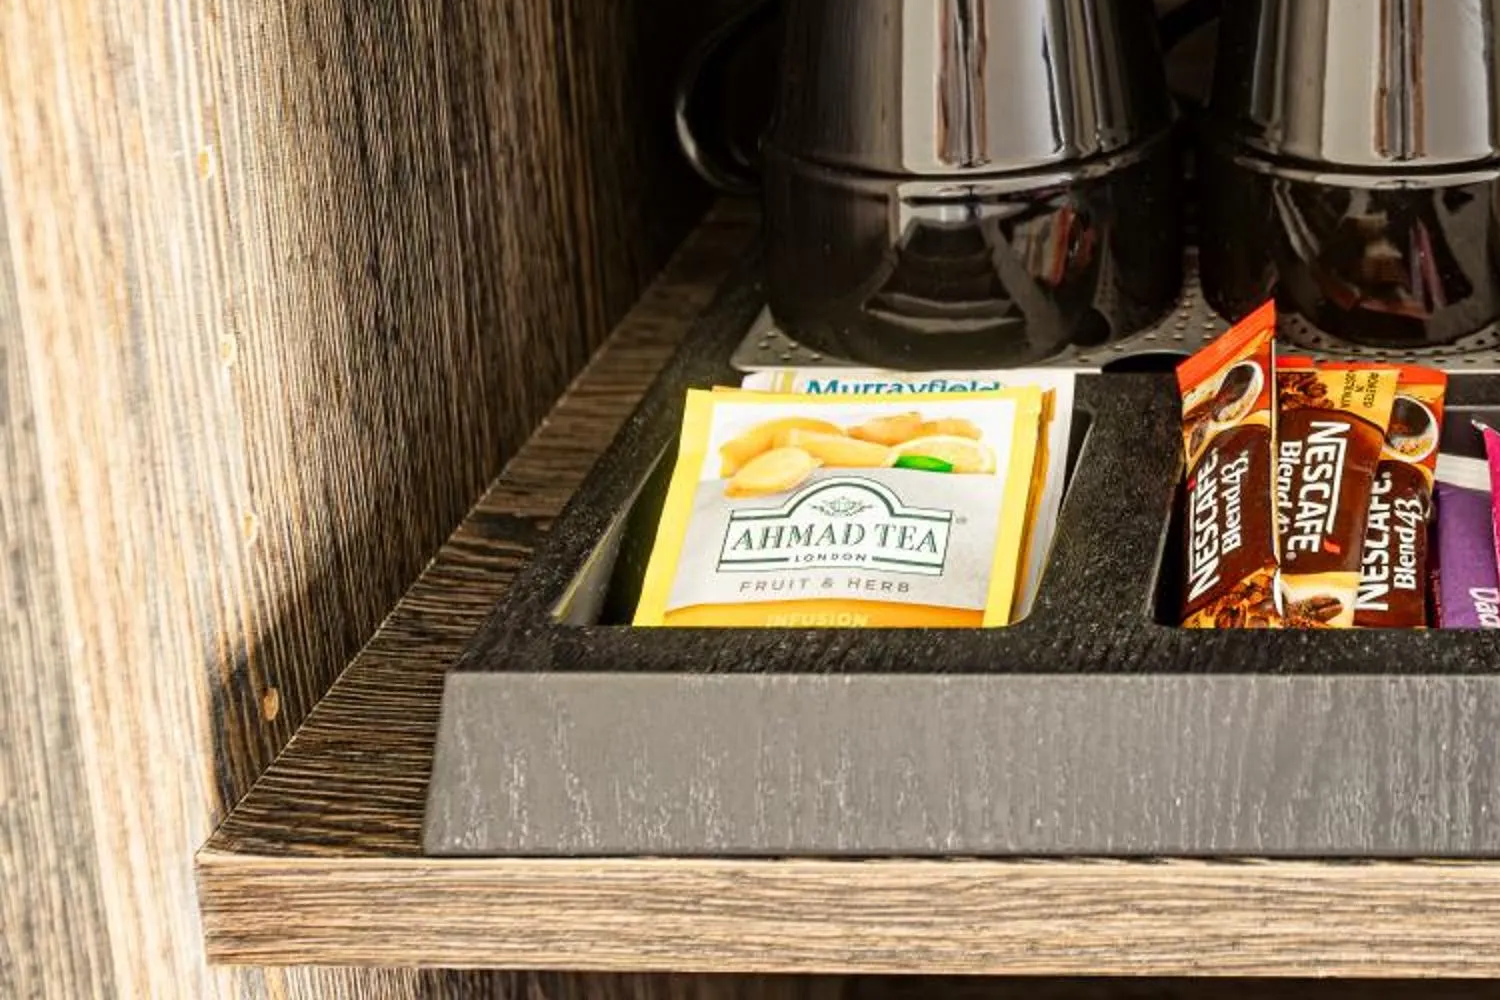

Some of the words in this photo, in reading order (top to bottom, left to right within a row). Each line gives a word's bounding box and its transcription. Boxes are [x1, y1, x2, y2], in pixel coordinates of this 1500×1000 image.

[731, 523, 866, 551] AHMAD
[874, 522, 939, 553] TEA
[793, 552, 868, 563] LONDON
[738, 576, 814, 593] FRUIT
[819, 576, 834, 589] &
[846, 576, 911, 593] HERB
[764, 611, 870, 628] INFUSION
